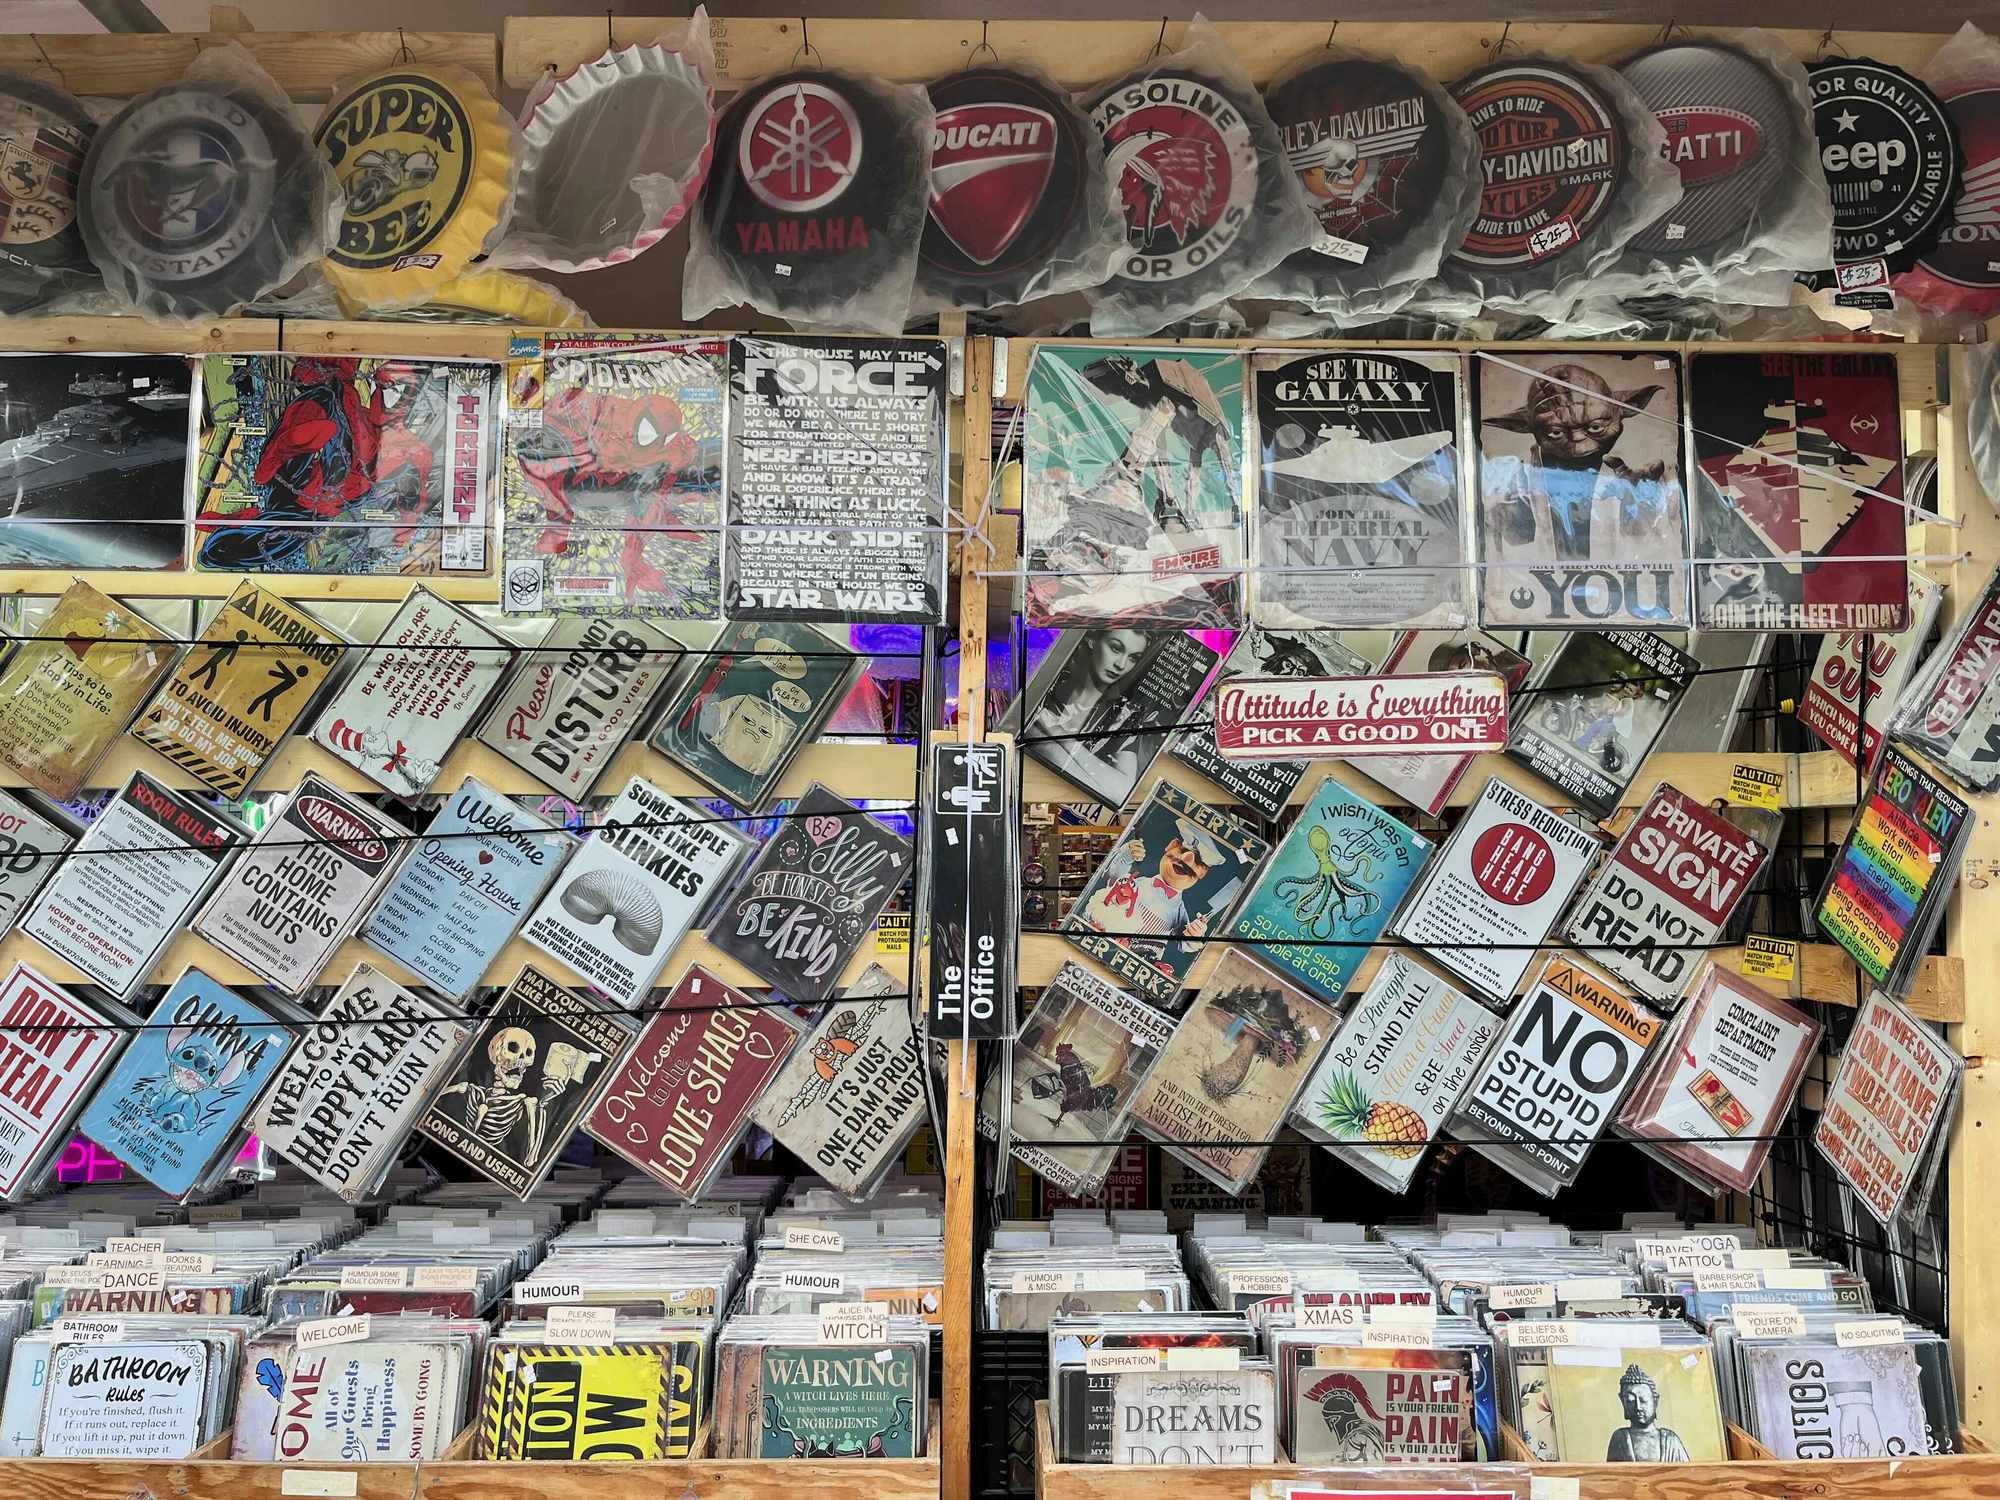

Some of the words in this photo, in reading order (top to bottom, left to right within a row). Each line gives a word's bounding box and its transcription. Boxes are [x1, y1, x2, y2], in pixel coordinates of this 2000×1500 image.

[1469, 104, 1496, 127] LIVE
[1498, 98, 1514, 113] TO
[1516, 98, 1545, 114] RIDE
[1855, 76, 1930, 126] QUALITY
[325, 88, 454, 166] SUPER
[1902, 150, 1943, 228] RELIABLE
[338, 203, 432, 254] BEE
[736, 216, 869, 256] YAMAHA
[1187, 204, 1247, 267] OILS
[1476, 219, 1505, 236] RIDE
[1506, 219, 1522, 235] TO
[1522, 210, 1550, 232] LIVE
[744, 358, 928, 396] FORCE
[1306, 359, 1349, 381] SEE
[1351, 358, 1399, 381] THE
[826, 397, 848, 408] US
[855, 398, 927, 410] ALWAYS
[1274, 381, 1430, 402] GALAXY
[453, 395, 480, 523] TORMENT
[743, 448, 927, 467] NERF-HERDERS.
[742, 495, 785, 508] SUCH
[793, 496, 842, 510] THING
[849, 498, 870, 511] AS
[877, 498, 926, 512] LUCK.
[740, 530, 837, 546] DARK
[850, 531, 924, 548] SIDE
[1284, 538, 1430, 567] NAVY
[1151, 548, 1221, 572] EMPIRE
[739, 588, 824, 609] STAR
[834, 590, 925, 612] WARS
[1529, 570, 1675, 619] YOU
[256, 602, 339, 667] WARNING
[1708, 602, 1749, 629] JOIN
[1753, 603, 1788, 629] THE
[1790, 602, 1840, 629] FLEET
[1843, 603, 1902, 630] TODAY
[184, 689, 227, 724] AVOID
[506, 664, 553, 742] Please
[531, 630, 649, 774] DISTURB
[623, 670, 650, 704] VIBES
[1220, 688, 1330, 728] Attitude
[1337, 694, 1357, 718] is
[1367, 684, 1503, 725] Everything
[1242, 726, 1302, 745] PICK
[1312, 727, 1331, 743] A
[1338, 723, 1419, 741] GOOD
[1430, 720, 1487, 739] ONE
[1809, 690, 1837, 717] WHICH
[1836, 710, 1859, 735] WAY
[1825, 723, 1850, 750] COME
[1220, 771, 1279, 812] improves
[1733, 764, 1782, 787] CAUTION
[131, 782, 178, 820] ROOM
[176, 812, 226, 851] RULES
[627, 783, 675, 819] SOME
[672, 810, 731, 857] PEOPLE
[1182, 799, 1236, 840] VERT
[1485, 784, 1532, 826] STRESS
[1528, 806, 1596, 860] REDUCTION
[1935, 788, 1966, 818] REQUIRE
[456, 794, 544, 867] Welcome
[664, 831, 702, 862] LIKE
[811, 816, 836, 839] BE
[1502, 826, 1548, 867] BANG
[1650, 801, 1757, 879] PRIVATE
[296, 840, 343, 880] THIS
[598, 818, 704, 898] SLINKIES
[808, 827, 885, 913] Silly
[1492, 843, 1536, 886] HEAD
[1629, 826, 1739, 912] SIGN
[1880, 839, 1904, 864] Effort
[273, 853, 337, 906] HOME
[422, 838, 474, 886] Opening
[479, 872, 521, 912] Hours
[781, 872, 826, 904] HONEST
[1479, 863, 1531, 902] HERE
[1865, 864, 1895, 896] Energy
[241, 865, 339, 939] CONTAINS
[399, 881, 441, 913] WEDNESDAY:
[1601, 874, 1645, 912] DO
[1644, 902, 1705, 946] NOT
[245, 899, 302, 945] NUTS
[1579, 900, 1686, 985] READ
[1746, 937, 1795, 957] CAUTION
[938, 965, 962, 1020] The
[970, 935, 994, 1020] Office
[1109, 952, 1175, 1000] FERK?
[1307, 966, 1342, 995] once
[0, 986, 99, 1072] DON'T
[1363, 1021, 1405, 1077] STAND
[1395, 982, 1432, 1022] TALL
[1573, 982, 1652, 1038] WARNING
[1726, 1001, 1781, 1042] COMPLAINT
[173, 995, 270, 1078] OHANA
[1127, 1019, 1165, 1047] EEFFOC
[1464, 1024, 1492, 1066] inside
[1511, 992, 1631, 1094] NO
[1713, 1018, 1777, 1063] DEPARTMENT
[266, 985, 381, 1129] WELCOME
[605, 1007, 693, 1124] Welcome
[824, 1076, 860, 1118] IT'S
[857, 1035, 893, 1078] JUST
[286, 1071, 367, 1176] HAPPY
[352, 996, 434, 1081] PLACE
[649, 1093, 715, 1187] LOVE
[686, 992, 761, 1105] SHACK
[1497, 1051, 1600, 1128] STUPID
[327, 1110, 388, 1184] DON'T
[380, 1051, 430, 1114] RUIN
[816, 1122, 850, 1168] ONE
[849, 1087, 884, 1135] DAM
[1479, 1074, 1590, 1157] PEOPLE
[423, 1113, 459, 1144] LONG
[484, 1152, 529, 1192] USEFUL
[841, 1119, 896, 1177] AFTER
[1535, 1144, 1571, 1176] POINT
[110, 1243, 162, 1253] TEACHER
[788, 1233, 810, 1244] SHE
[812, 1235, 840, 1246] CAVE
[104, 1272, 159, 1288] DANCE
[522, 1285, 580, 1299] HUMOUR
[785, 1274, 840, 1288] HUMOUR
[1024, 1274, 1063, 1282] HUMOUR
[1232, 1275, 1289, 1284] PROFESSIONS
[63, 1322, 118, 1333] BATHROOM
[302, 1323, 366, 1342] WELCOME
[823, 1323, 883, 1339] WITCH
[1304, 1310, 1354, 1325] XMAS
[1518, 1325, 1557, 1335] BELIEFS
[1754, 1325, 1794, 1336] CAMERA
[1855, 1328, 1900, 1338] SOLICITING
[1367, 1332, 1430, 1345] INSPIRATION
[68, 1356, 192, 1387] BATHROOM
[415, 1359, 432, 1400] GOING
[765, 1356, 909, 1388] WARNING
[1090, 1356, 1156, 1367] INSPIRATION
[342, 1359, 360, 1423] Guests
[376, 1358, 397, 1451] Happiness
[793, 1391, 827, 1401] WITCH
[861, 1391, 889, 1401] HERE
[1386, 1374, 1460, 1403] PAIN
[796, 1417, 879, 1429] INGREDIENTS
[1124, 1405, 1263, 1435] DREAMS
[1399, 1404, 1424, 1413] YOUR
[1426, 1404, 1459, 1414] FRIEND
[1385, 1415, 1458, 1444] PAIN
[1400, 1444, 1428, 1454] YOUR
[1432, 1445, 1457, 1454] ALLY
